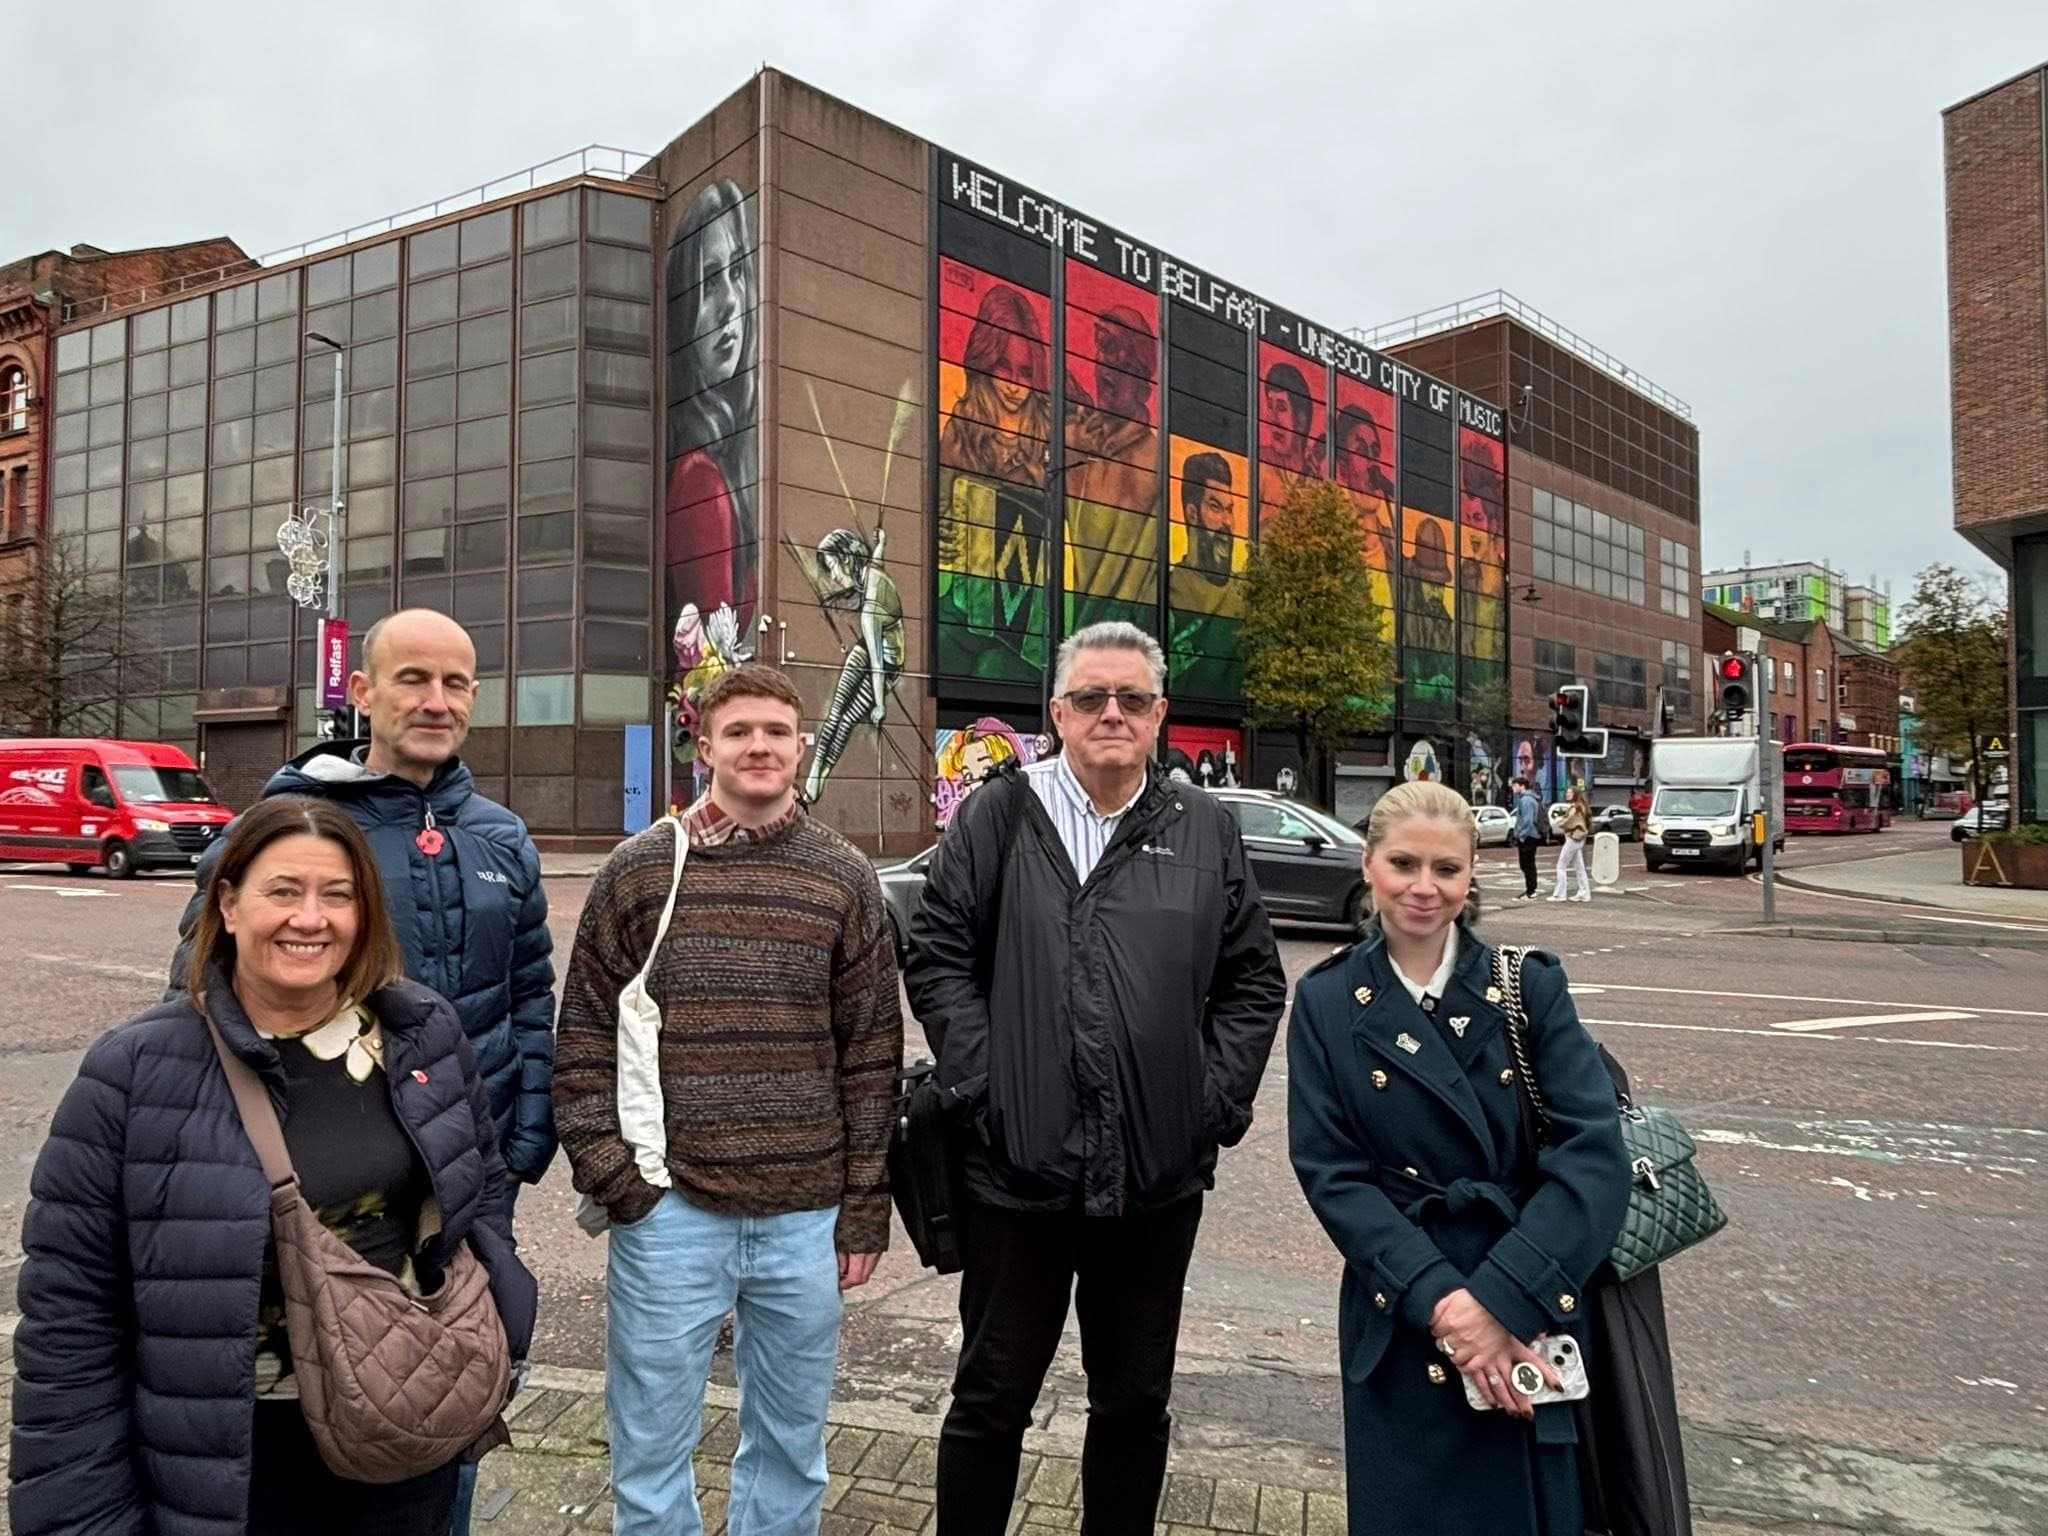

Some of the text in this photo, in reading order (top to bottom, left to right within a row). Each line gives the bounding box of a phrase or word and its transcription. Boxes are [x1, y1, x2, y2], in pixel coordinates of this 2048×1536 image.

[952, 162, 1098, 261] WELCOME
[1114, 236, 1151, 284] TO
[1161, 260, 1271, 335] BELFAST
[1297, 322, 1372, 380] UNESCO
[1379, 362, 1421, 401] CITY
[1428, 387, 1450, 412] OF
[1459, 397, 1502, 436] MUSIC
[329, 637, 343, 687] Belfast
[1036, 739, 1048, 749] 30
